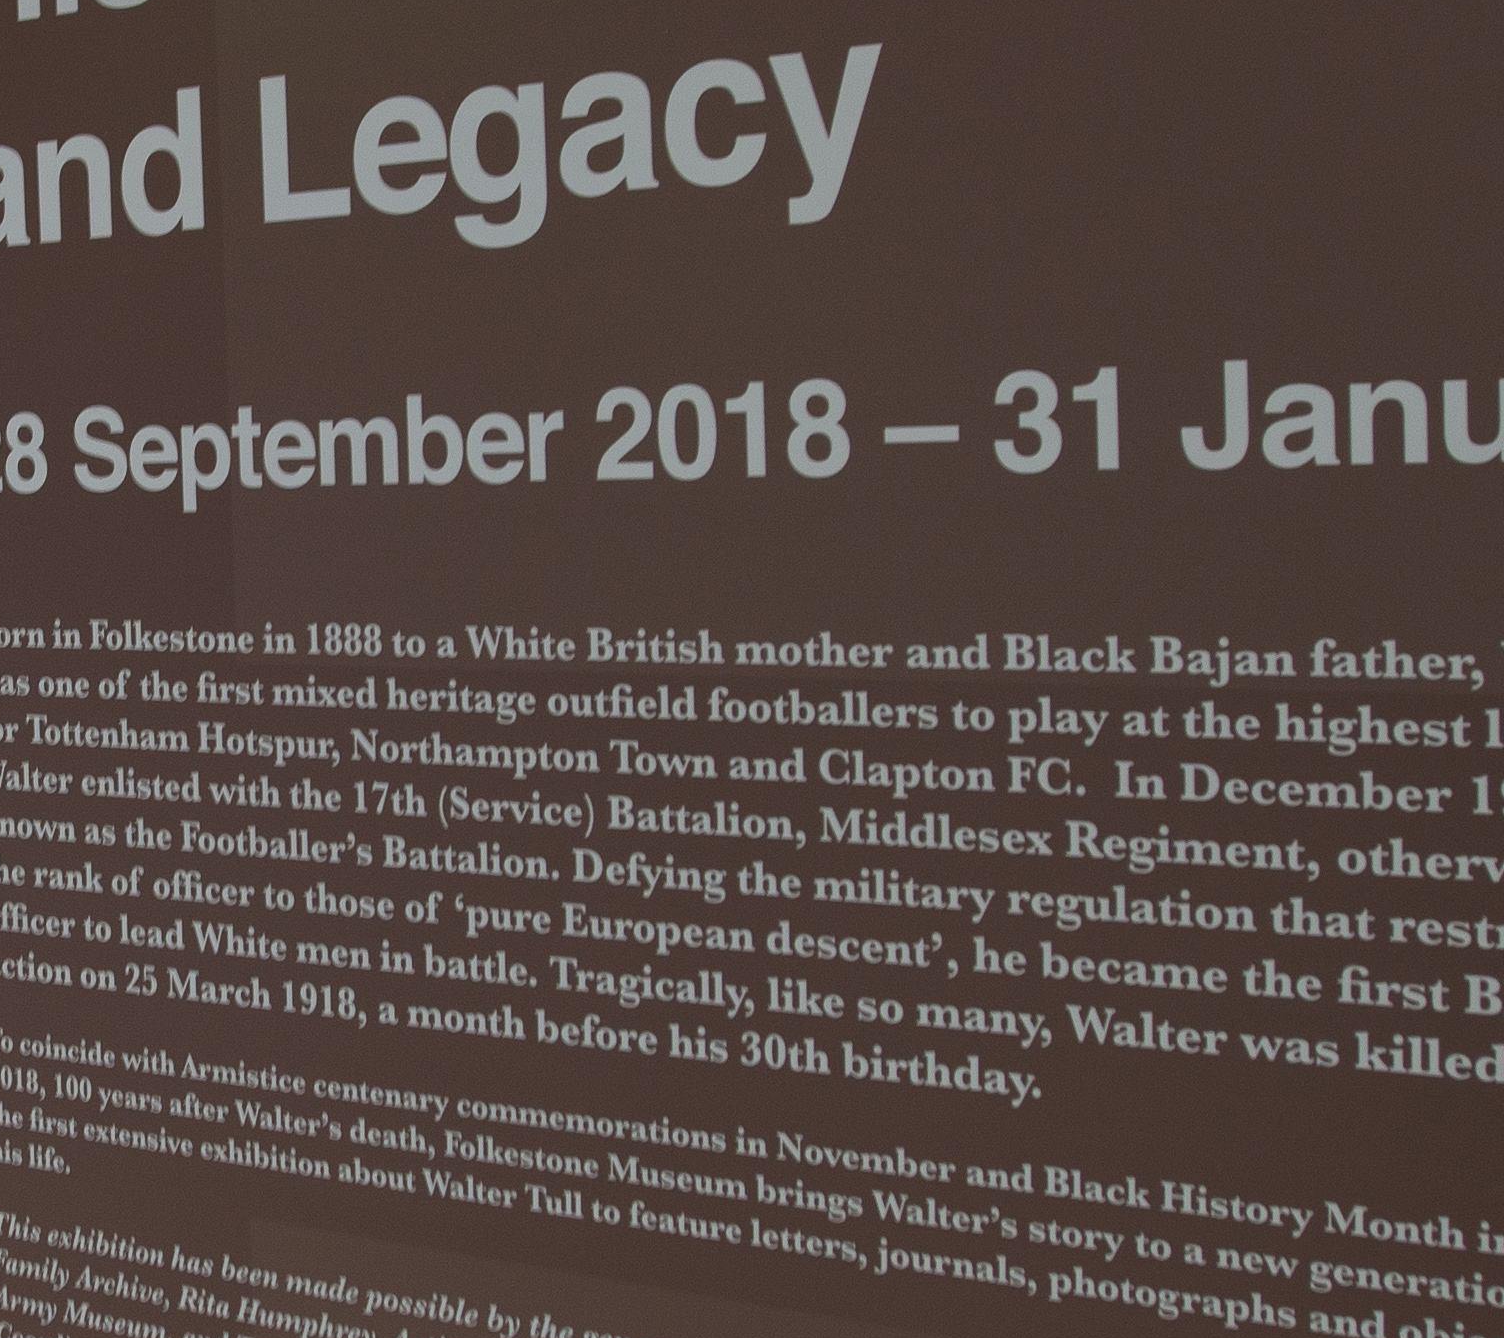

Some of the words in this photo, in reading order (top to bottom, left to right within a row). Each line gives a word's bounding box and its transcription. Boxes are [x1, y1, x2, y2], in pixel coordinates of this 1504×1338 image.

[259, 43, 883, 249] Legacy
[73, 393, 564, 513] September
[595, 378, 851, 481] 2018
[883, 424, 960, 444] –
[993, 366, 1120, 474] 31
[38, 676, 90, 699] one
[98, 668, 132, 700] of
[140, 669, 188, 702] the
[197, 671, 264, 705] first
[272, 674, 378, 709] mixed
[386, 677, 536, 725] heritage
[547, 683, 698, 721] outfield
[708, 686, 939, 729] footballers
[951, 700, 995, 731] to
[1008, 695, 1109, 747] play
[1122, 706, 1170, 738] at
[1182, 700, 1261, 741] the
[1275, 702, 1471, 756] highest
[52, 618, 82, 649] in
[89, 619, 254, 654] Folkestone
[263, 621, 297, 654] in
[307, 622, 383, 657] 1888
[392, 631, 426, 658] to
[436, 636, 458, 658] a
[465, 625, 576, 661] White
[587, 627, 725, 664] British
[735, 631, 894, 668] mother
[906, 633, 991, 670] and
[1003, 633, 1137, 673] Black
[1149, 635, 1297, 688] Bajan
[1309, 637, 1485, 691] father,
[19, 1034, 116, 1068] coincide
[121, 1047, 175, 1076] with
[181, 1053, 306, 1094] Armistice
[313, 1079, 449, 1122] centenary
[456, 1099, 727, 1152] commemorations
[736, 1126, 768, 1158] in
[777, 1131, 957, 1182] November
[966, 1163, 1034, 1193] and
[1044, 1165, 1150, 1209] Black
[1161, 1180, 1314, 1239] History
[1325, 1201, 1466, 1250] Month
